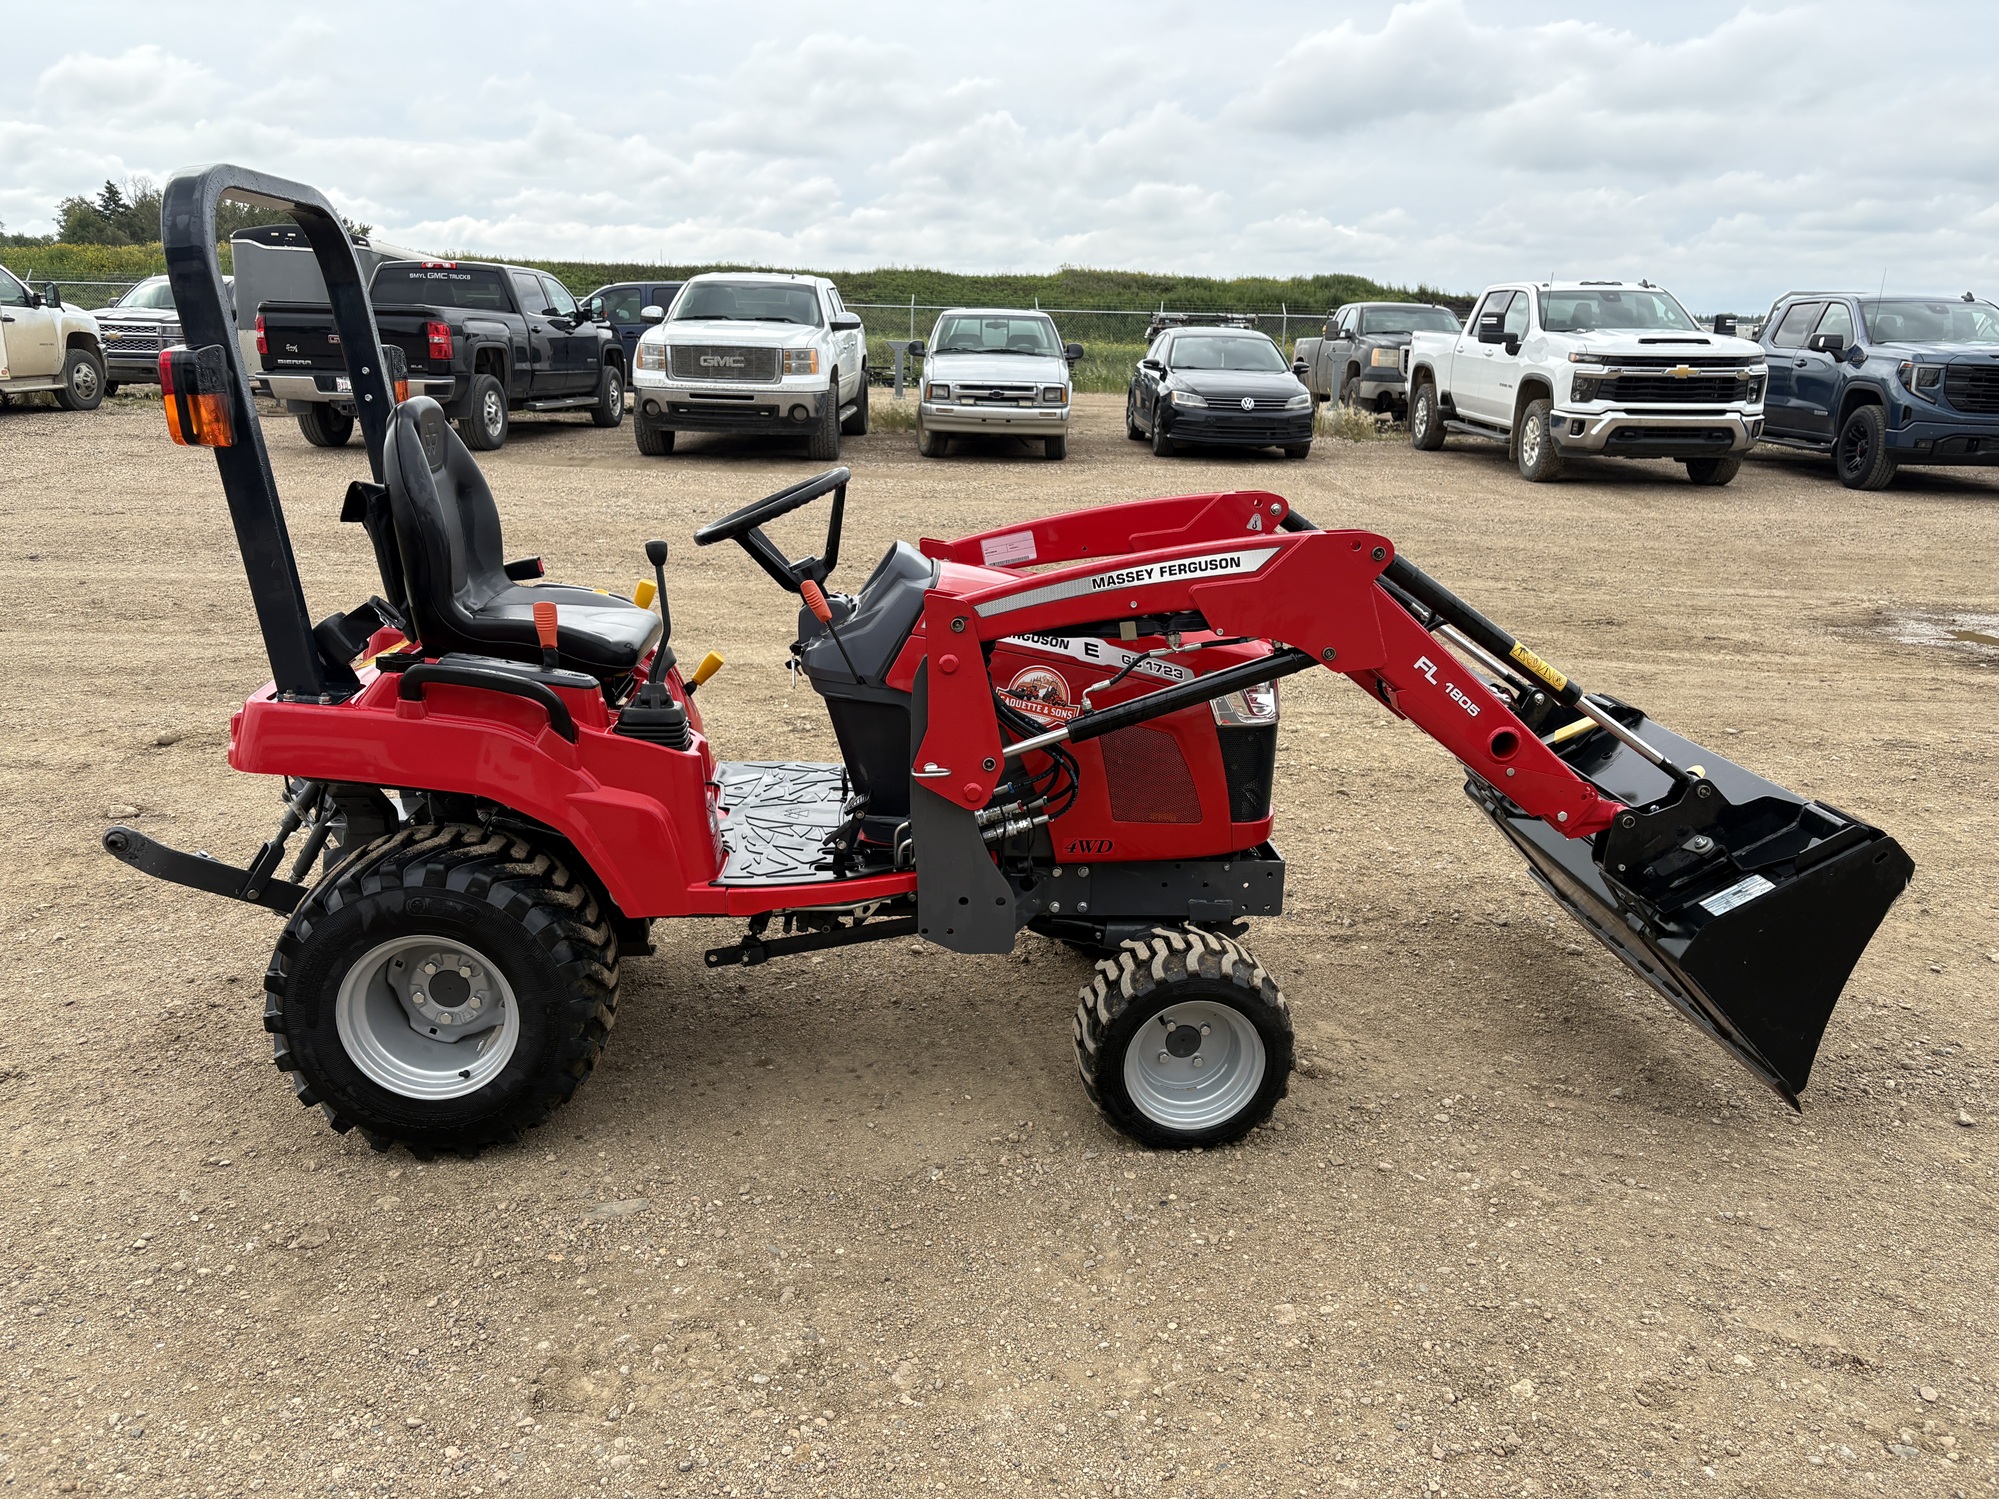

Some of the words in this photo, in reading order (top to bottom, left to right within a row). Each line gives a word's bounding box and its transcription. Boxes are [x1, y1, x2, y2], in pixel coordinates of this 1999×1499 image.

[427, 272, 448, 280] GMC
[449, 273, 471, 281] TRUCKS
[700, 355, 745, 368] GMC
[1091, 568, 1154, 590] MASSEY
[1159, 556, 1241, 578] FERGUSON
[1084, 641, 1100, 658] E
[1145, 661, 1184, 680] 1723
[1413, 655, 1438, 686] FL
[1444, 682, 1481, 717] 1805
[1043, 706, 1049, 714] &
[1050, 707, 1074, 720] SONS
[1064, 839, 1114, 854] 4WD
